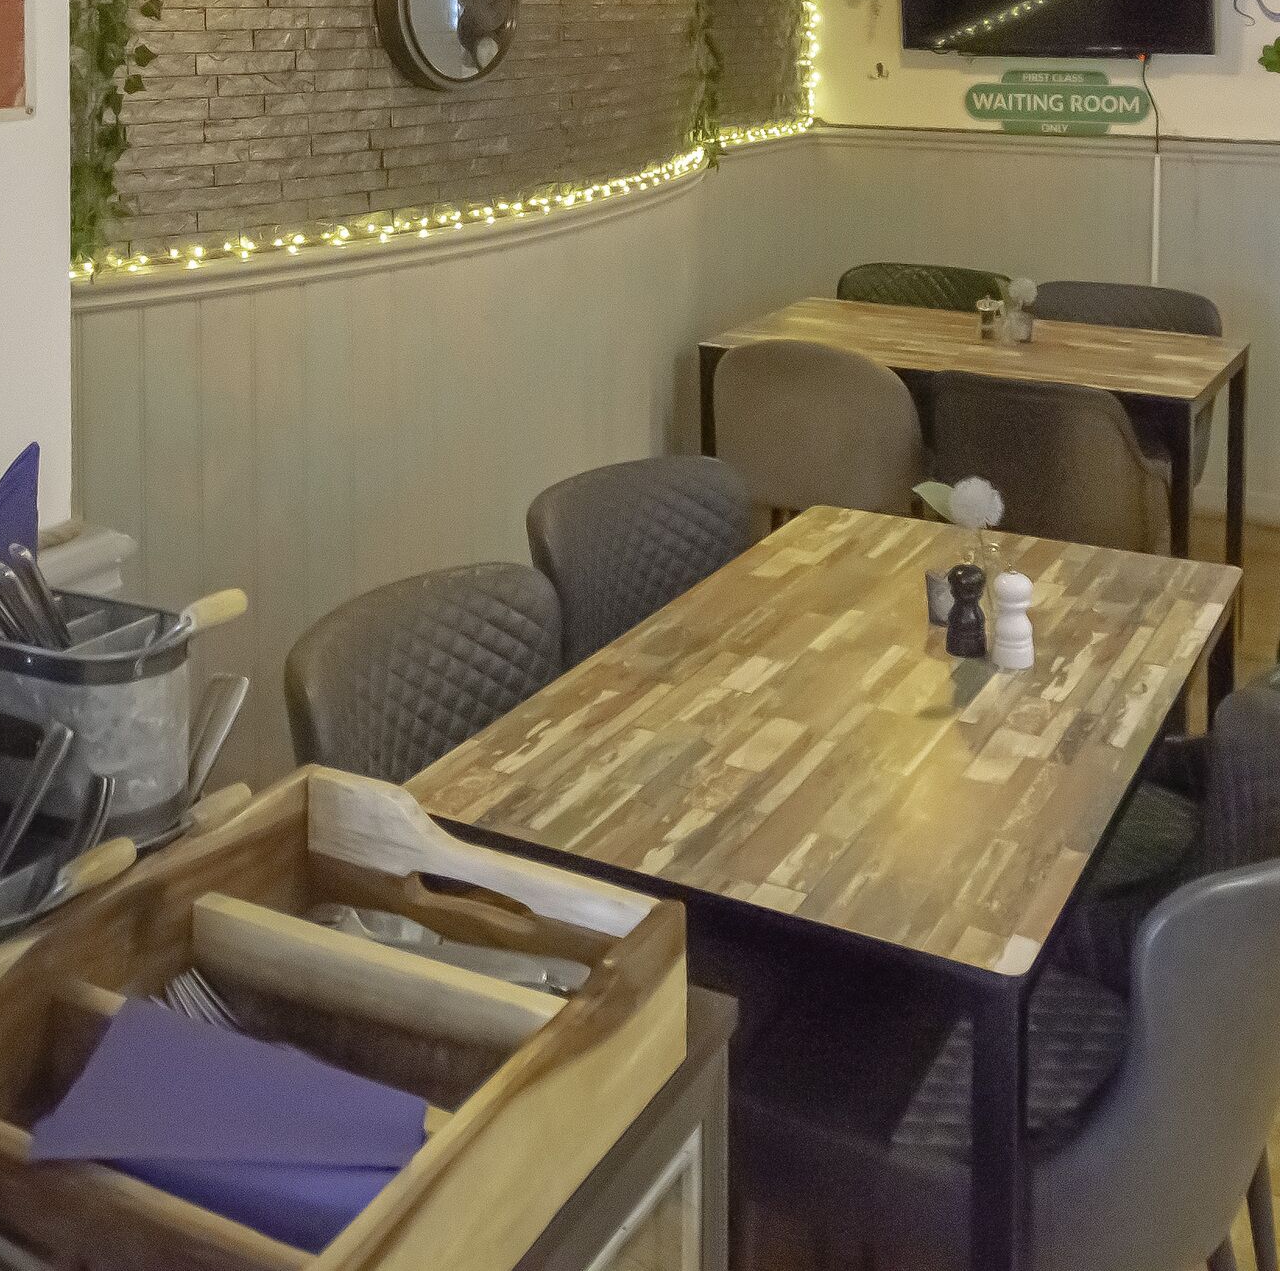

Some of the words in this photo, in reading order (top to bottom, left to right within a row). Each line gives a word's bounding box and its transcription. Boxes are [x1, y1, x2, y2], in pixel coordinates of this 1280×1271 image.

[1022, 72, 1049, 83] FIRST
[1052, 72, 1085, 83] CLASS
[972, 91, 1064, 112] WAITING
[1070, 94, 1140, 114] ROOM
[1041, 123, 1070, 134] ONLY
